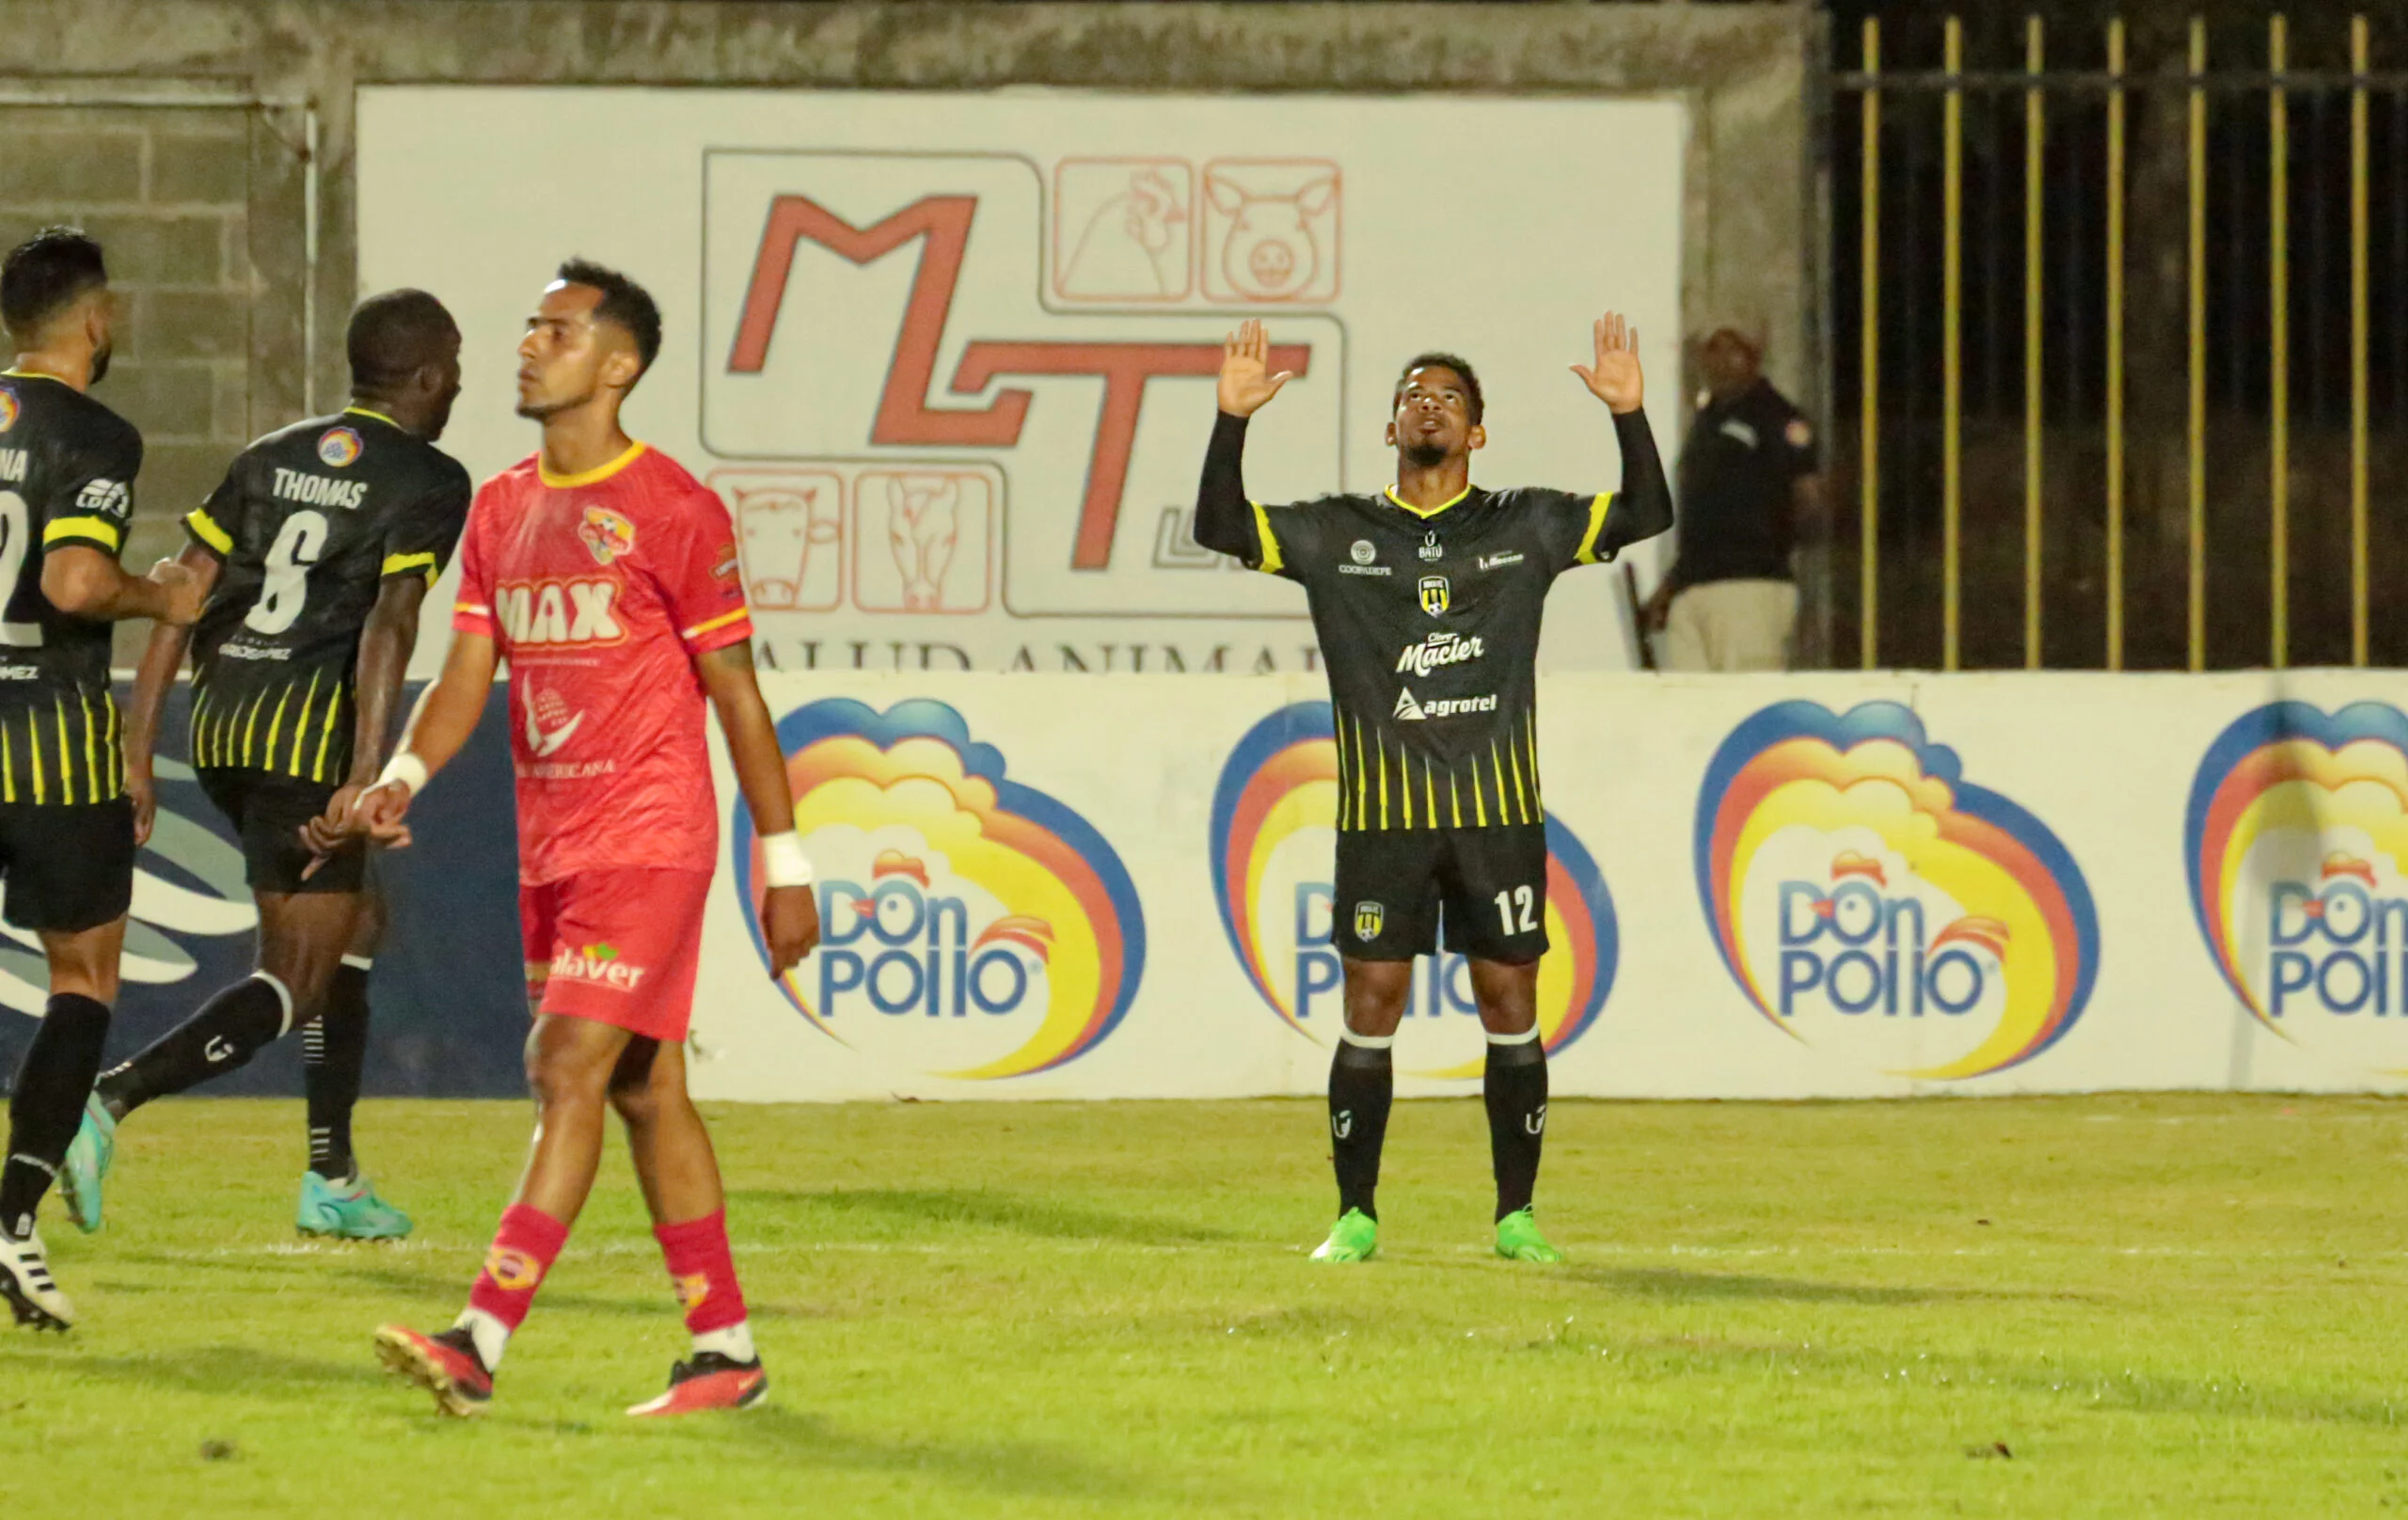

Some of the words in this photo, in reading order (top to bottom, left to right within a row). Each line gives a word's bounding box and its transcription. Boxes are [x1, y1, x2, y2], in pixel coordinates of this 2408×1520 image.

[273, 467, 369, 510] THOMAS
[245, 511, 327, 635] 6
[496, 582, 622, 643] MAX
[1396, 636, 1484, 677] Macier
[1424, 694, 1497, 717] agrotel
[1495, 884, 1539, 937] 12
